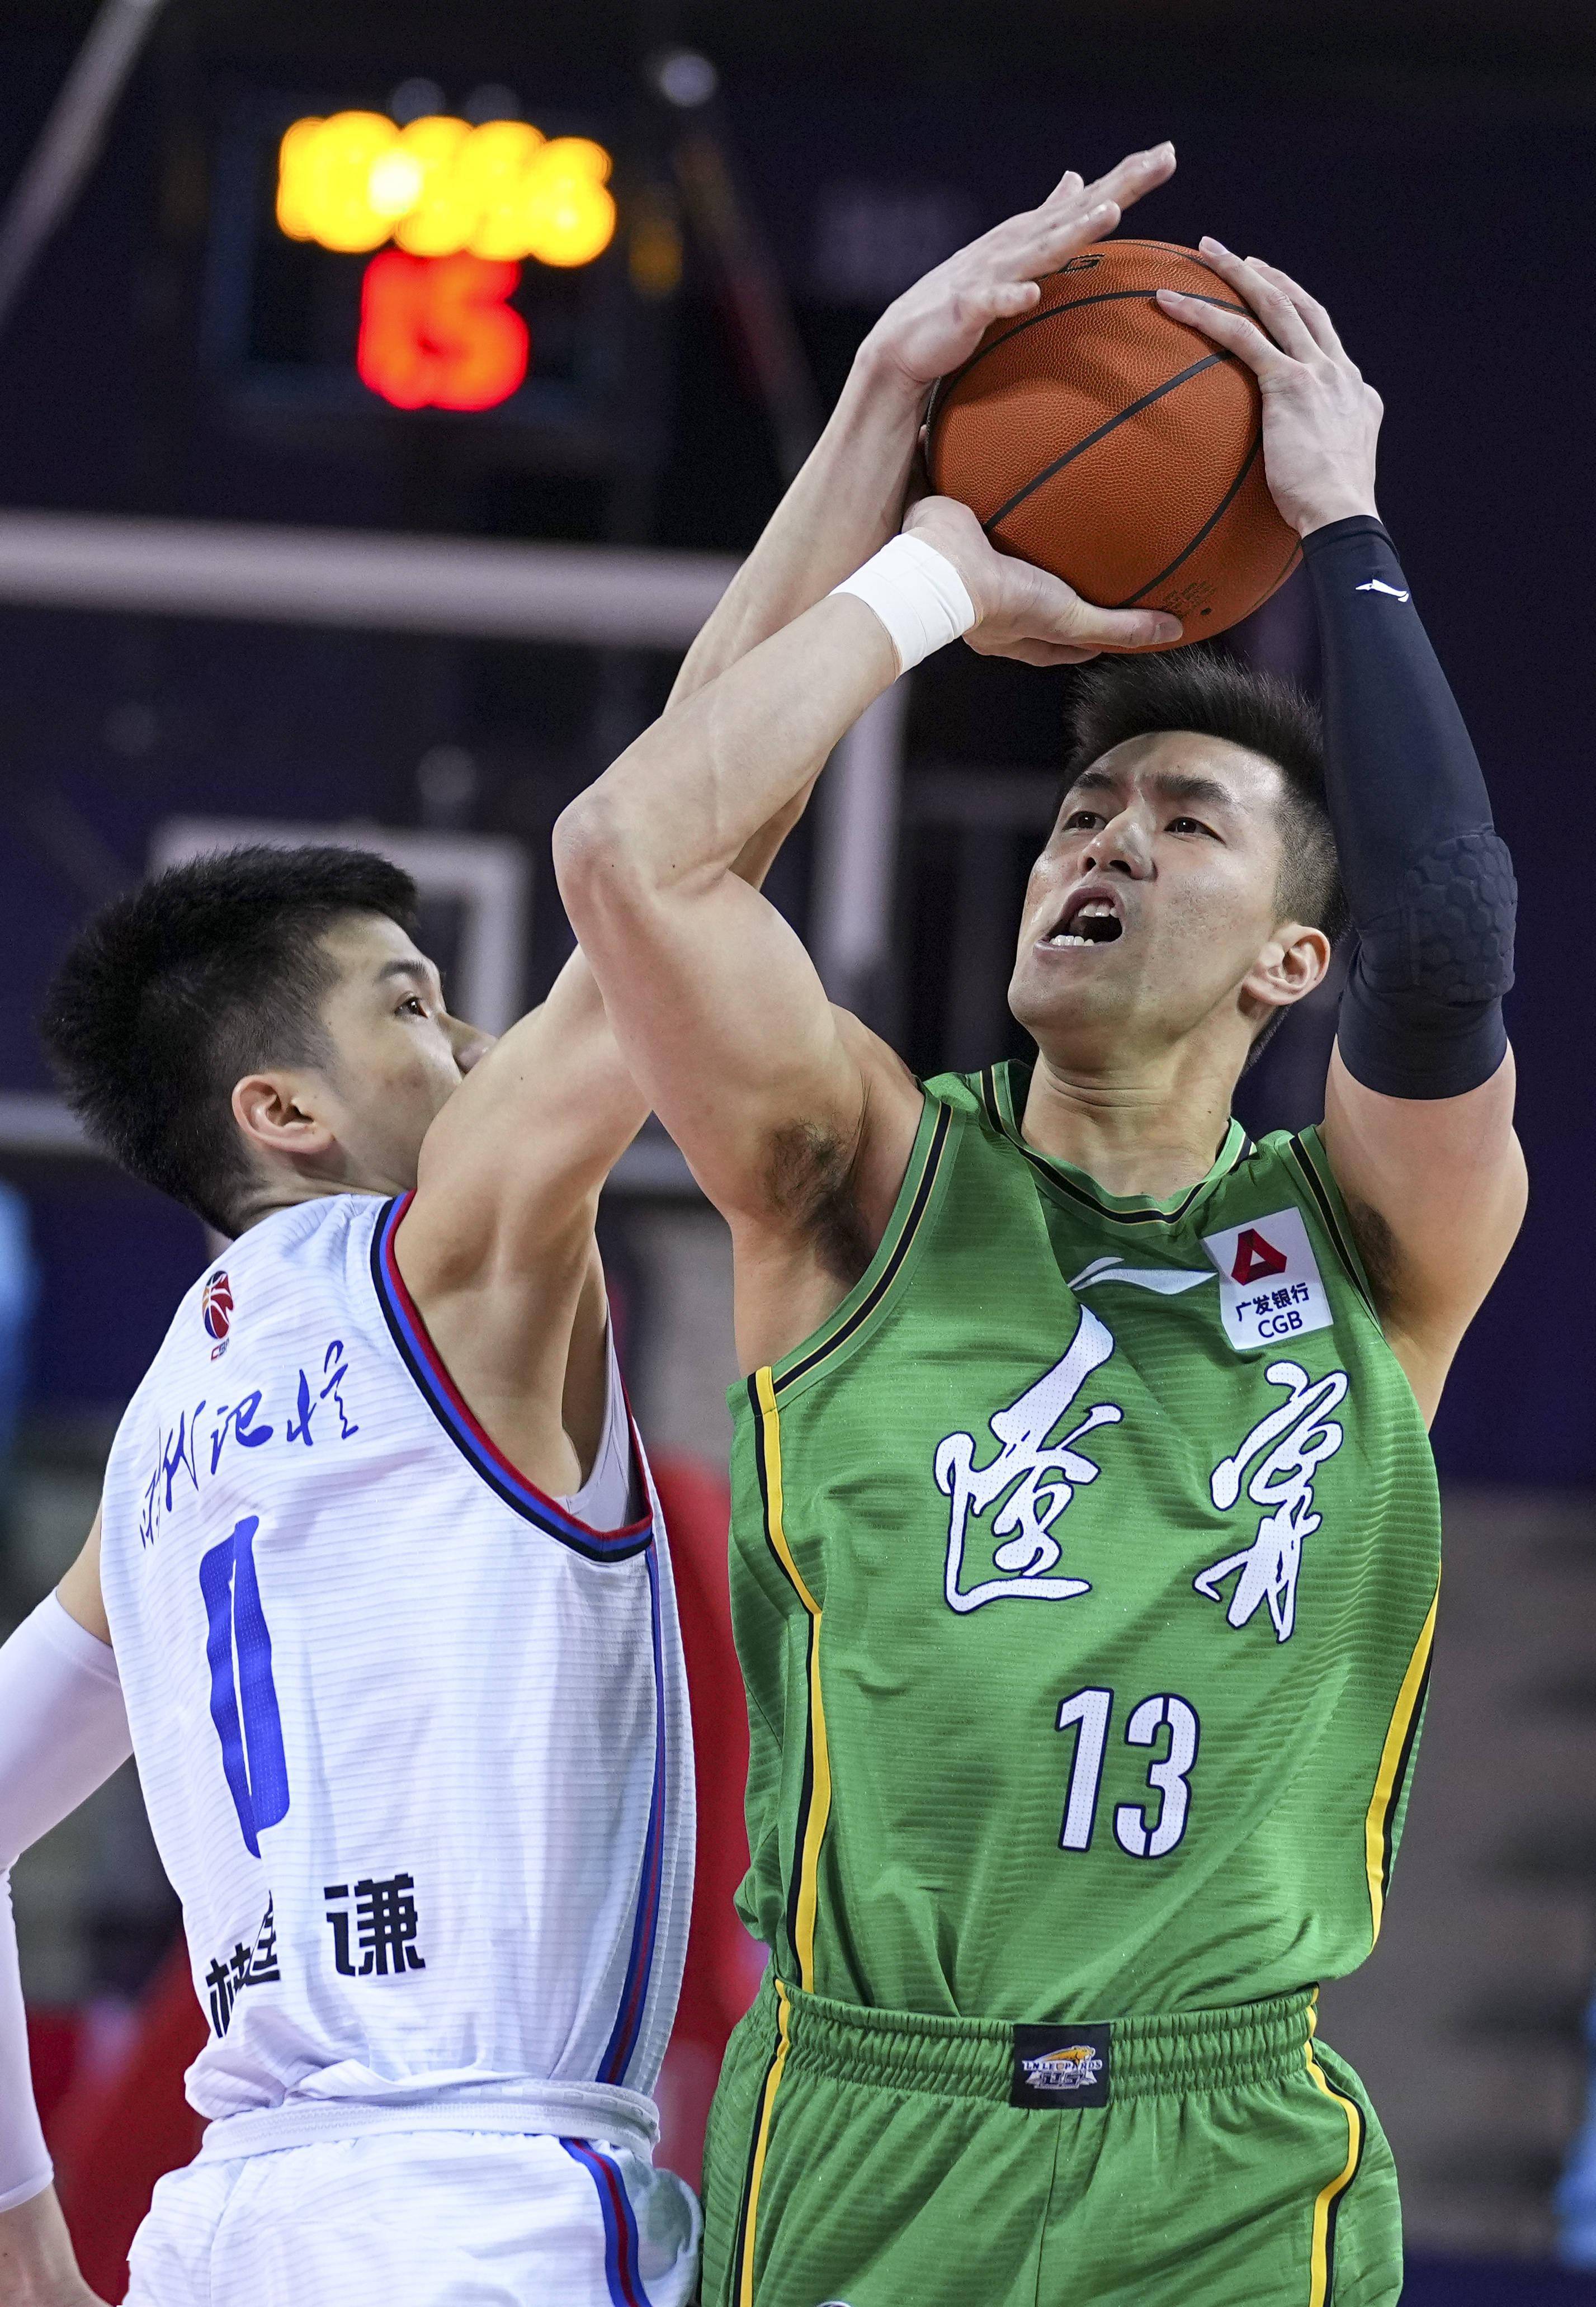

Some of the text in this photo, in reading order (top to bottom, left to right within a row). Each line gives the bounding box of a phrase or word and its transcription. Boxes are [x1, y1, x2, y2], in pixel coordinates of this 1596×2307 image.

[1235, 1282, 1310, 1322] 广发银行
[1258, 1310, 1303, 1338] CGB
[1054, 1686, 1201, 1860] 13
